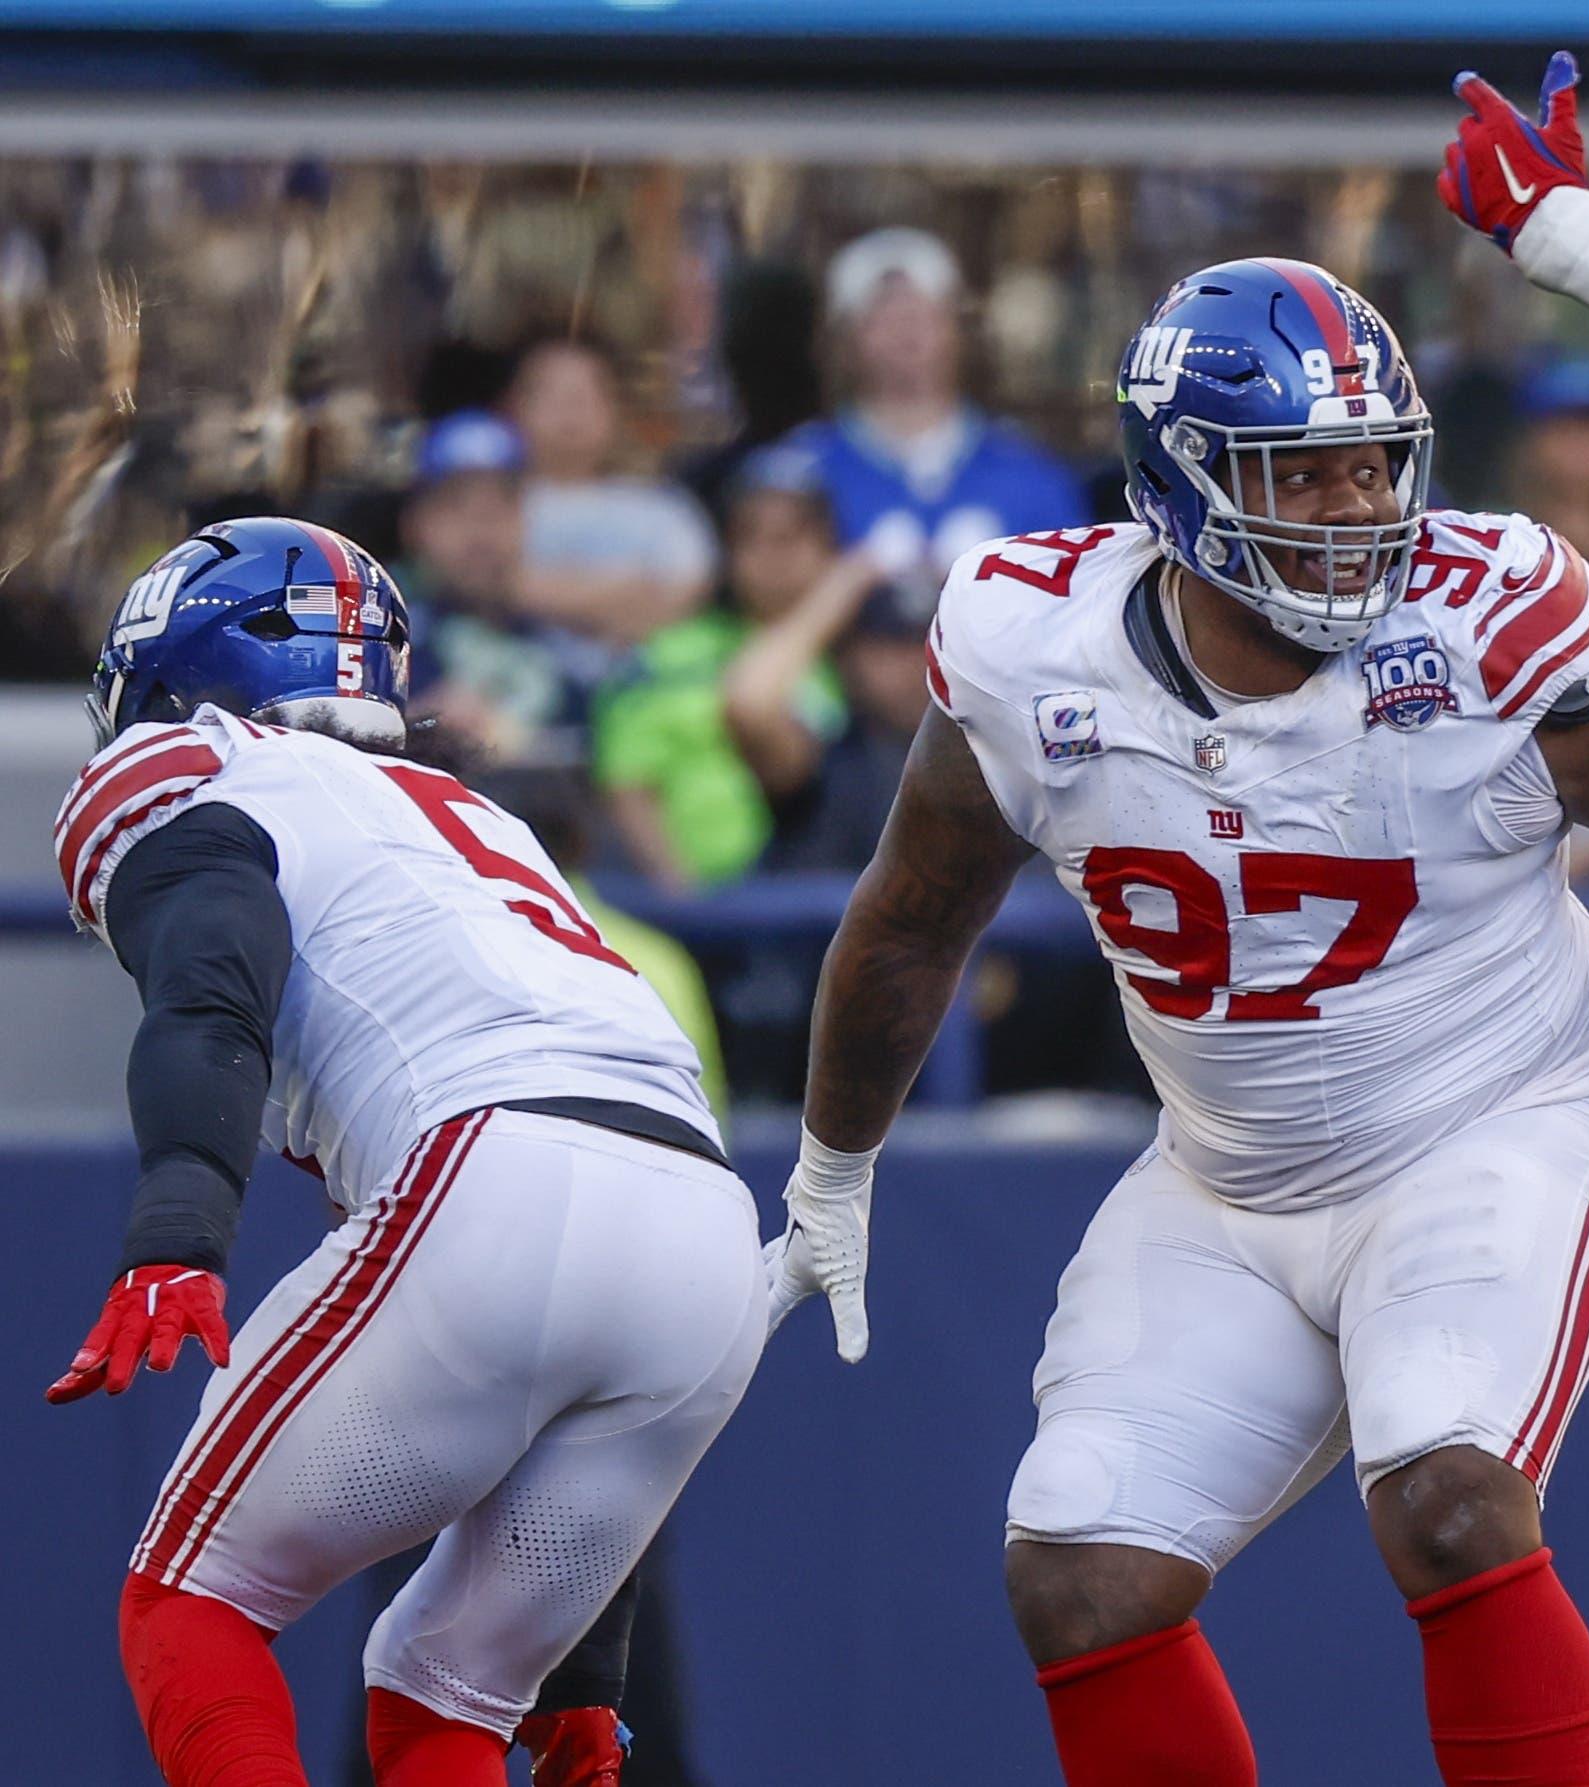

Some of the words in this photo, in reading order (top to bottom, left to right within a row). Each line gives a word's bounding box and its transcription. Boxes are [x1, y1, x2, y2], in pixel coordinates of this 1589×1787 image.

[1301, 344, 1381, 397] 97
[336, 642, 364, 691] 5
[1362, 650, 1449, 699] 100
[1375, 687, 1444, 708] SEASONS
[1198, 749, 1223, 768] NFL
[371, 761, 640, 977] 5
[1081, 845, 1420, 1021] 97
